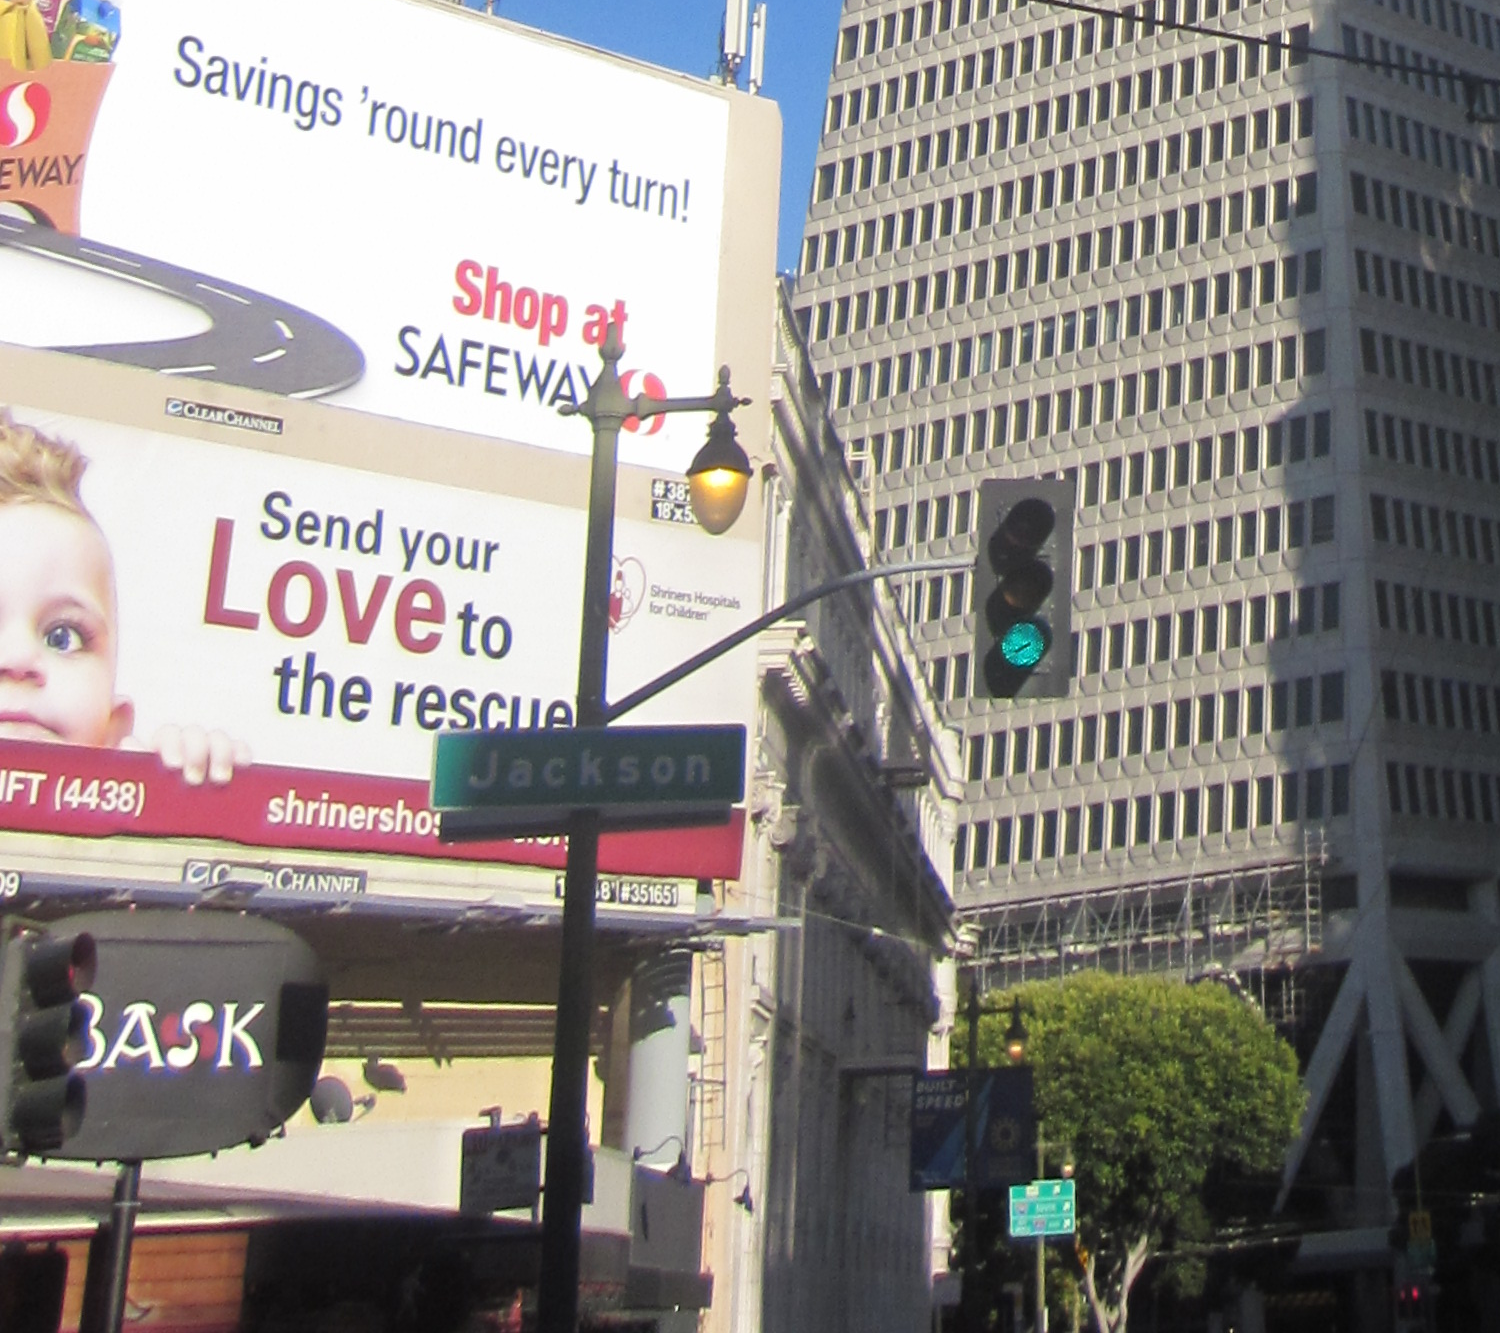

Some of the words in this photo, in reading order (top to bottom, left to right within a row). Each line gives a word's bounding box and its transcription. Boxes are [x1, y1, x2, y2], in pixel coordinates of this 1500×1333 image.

[174, 35, 343, 131] Savings
[495, 136, 597, 205] every
[608, 159, 690, 223] turn!
[452, 259, 568, 346] Shop
[582, 299, 628, 352] at
[260, 490, 384, 556] Send
[399, 526, 500, 573] your
[203, 517, 446, 654] Love
[457, 601, 513, 659] to
[649, 601, 663, 615] for
[650, 584, 692, 603] Shriners
[694, 591, 740, 610] Hospitals
[274, 651, 373, 722] the
[391, 681, 574, 731] rescue
[468, 748, 712, 789] Jackson
[54, 774, 146, 817] (4438)
[620, 882, 678, 905] #351651
[74, 992, 266, 1069] BASK
[915, 1079, 957, 1093] BUILT
[915, 1093, 965, 1110] SPEED
